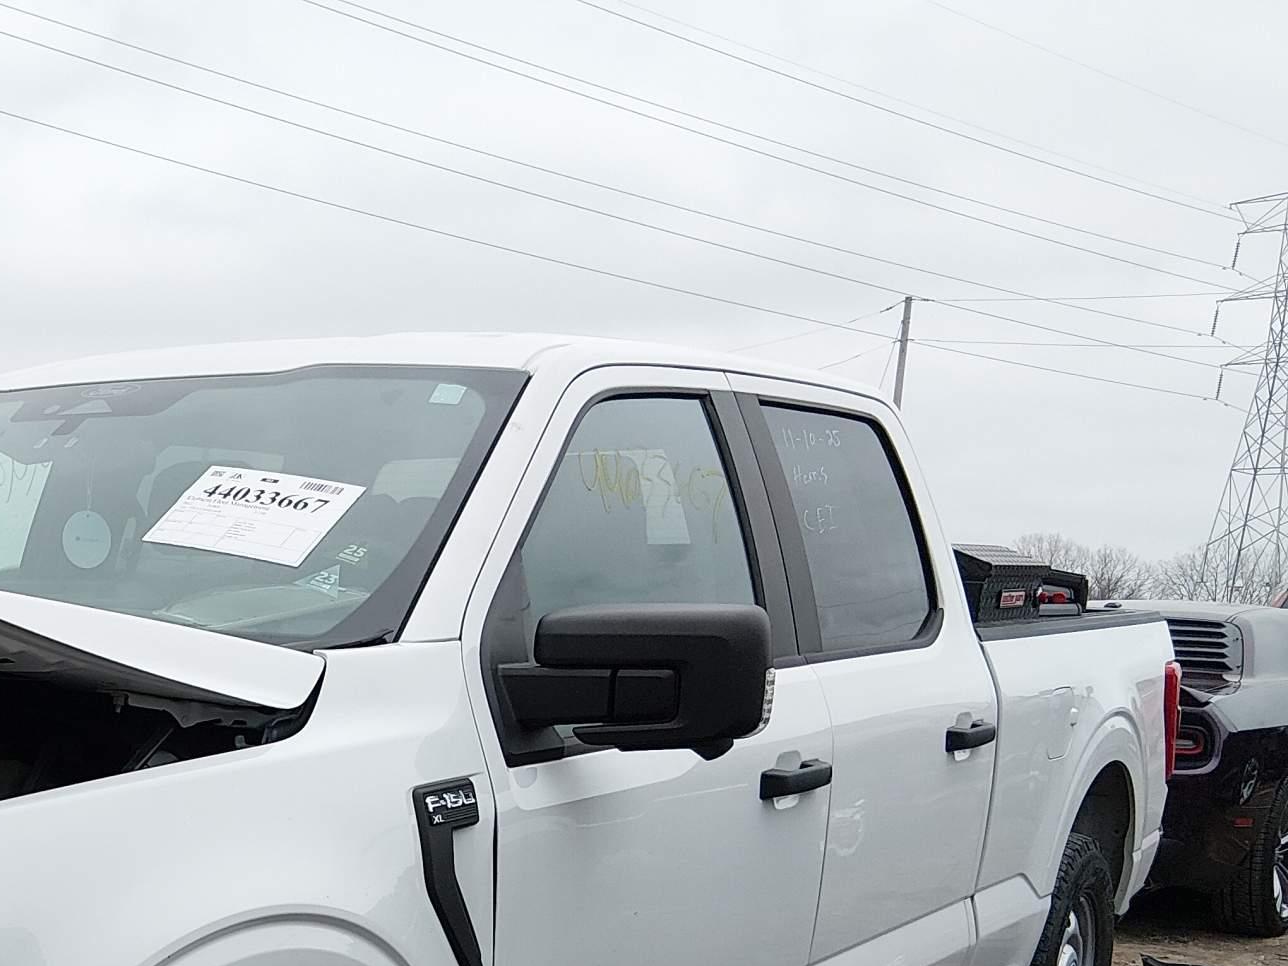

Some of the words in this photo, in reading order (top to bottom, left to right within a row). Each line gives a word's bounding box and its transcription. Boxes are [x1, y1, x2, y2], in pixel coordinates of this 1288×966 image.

[782, 427, 841, 450] 11-10-25
[203, 484, 330, 514] 44033667
[344, 544, 368, 557] 25
[314, 571, 338, 584] 23
[432, 814, 445, 825] XL
